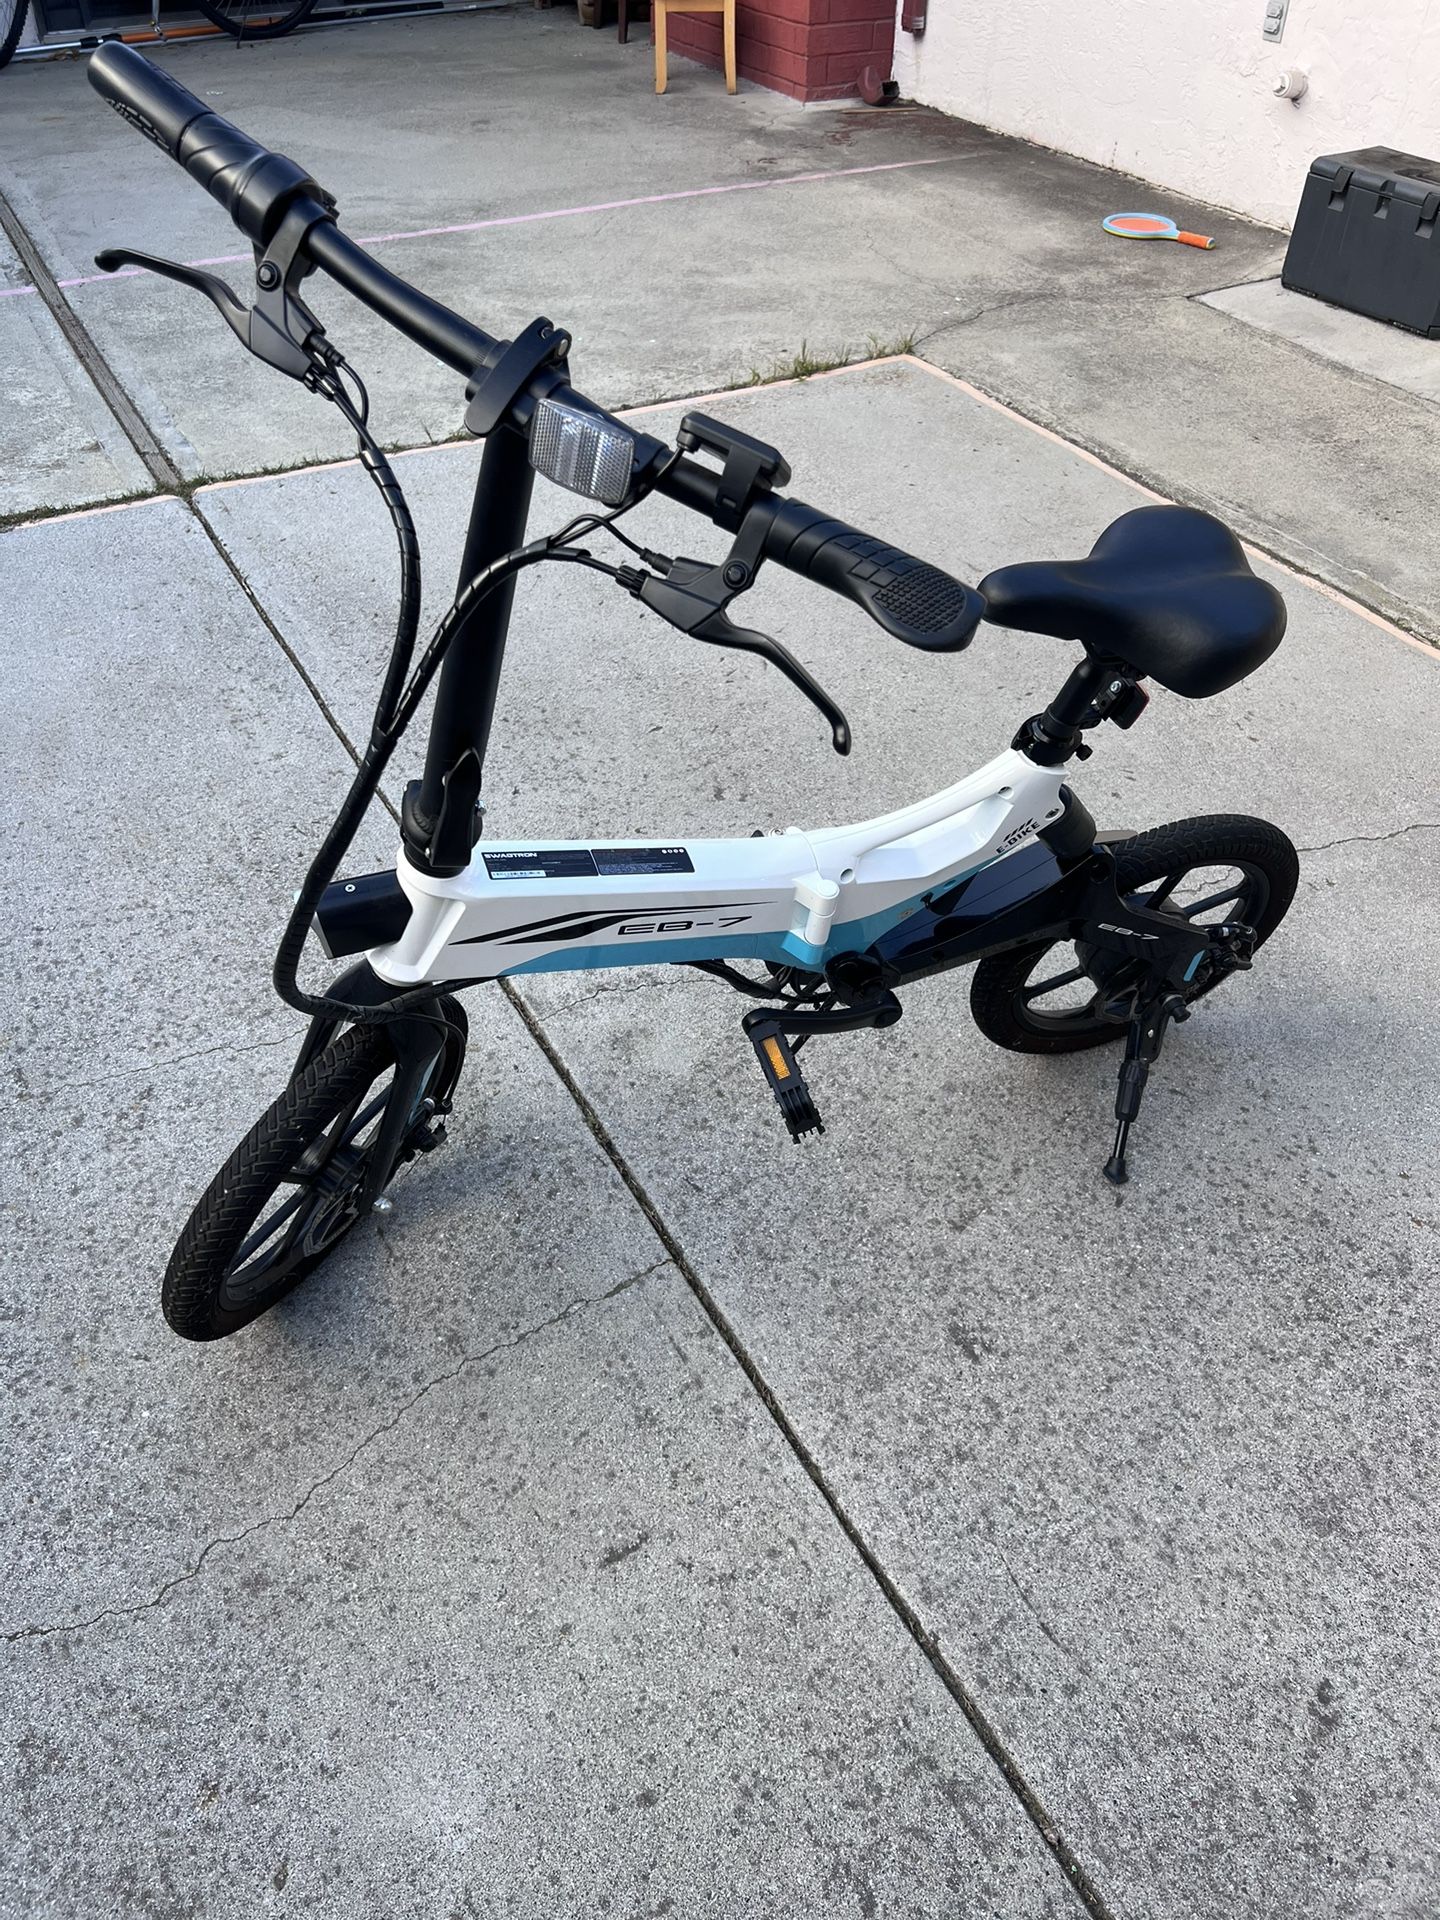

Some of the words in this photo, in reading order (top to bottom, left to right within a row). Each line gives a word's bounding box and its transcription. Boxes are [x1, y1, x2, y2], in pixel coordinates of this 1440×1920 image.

[996, 821, 1040, 853] E-BIKE
[618, 916, 752, 935] EB-7
[1098, 923, 1159, 939] EB-7
